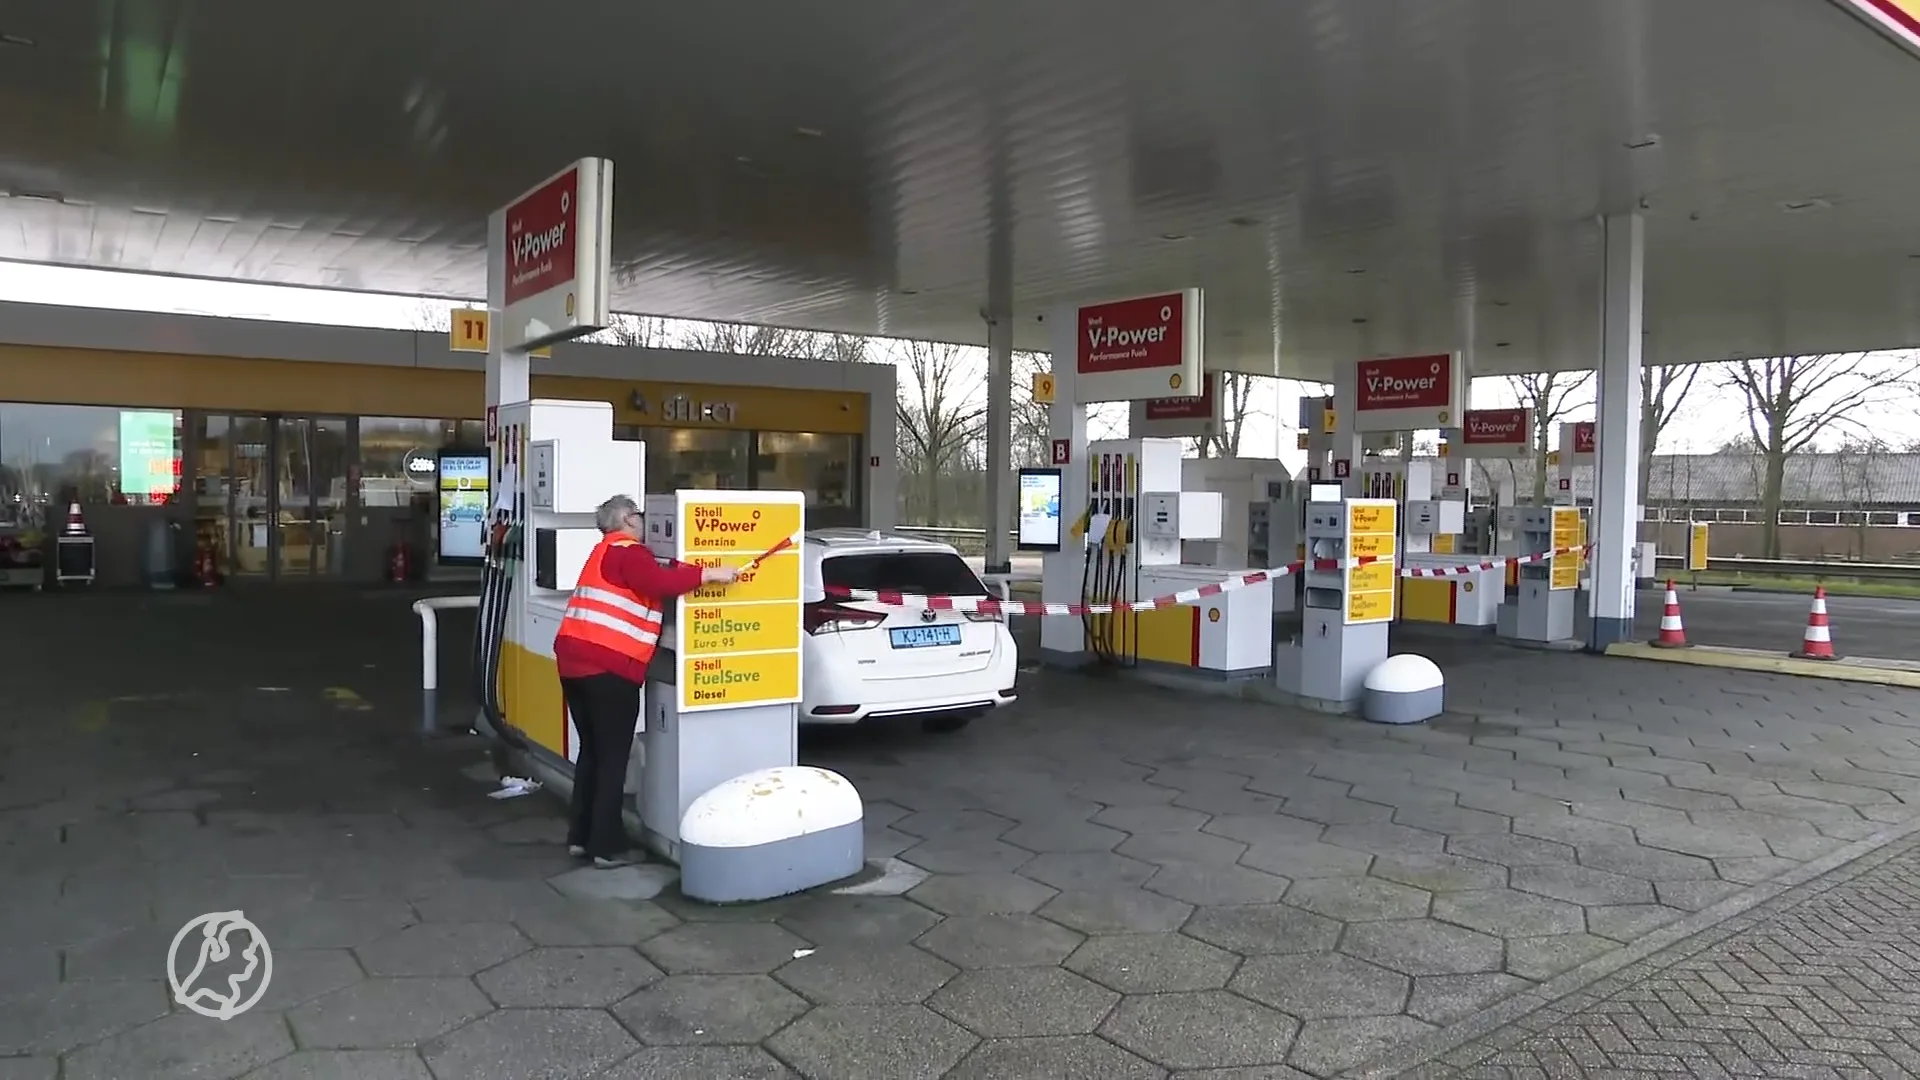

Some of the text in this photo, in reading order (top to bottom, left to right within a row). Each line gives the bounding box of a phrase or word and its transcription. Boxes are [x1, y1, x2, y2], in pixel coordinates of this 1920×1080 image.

[512, 221, 566, 266] V-Power
[463, 319, 484, 341] 11
[1088, 325, 1168, 349] V-Power
[1089, 348, 1147, 362] Performance Fuels
[1042, 380, 1052, 395] 9
[1366, 376, 1437, 393] V-Power
[662, 400, 737, 421] SELECT
[1470, 422, 1518, 433] V-Power
[1056, 443, 1066, 461] B
[1337, 462, 1348, 475] B
[694, 507, 722, 517] Shell
[695, 519, 757, 532] V-Power
[694, 537, 736, 547] Benzine
[694, 558, 722, 568] Shell
[694, 588, 726, 598] Diesel
[694, 609, 722, 619] Shell
[694, 619, 761, 634] FuelSave
[902, 627, 951, 643] KJ-141-H
[694, 637, 735, 649] Euro 95
[694, 660, 722, 671] Shell
[694, 670, 760, 686] FuelSave
[694, 689, 726, 700] Diesel
